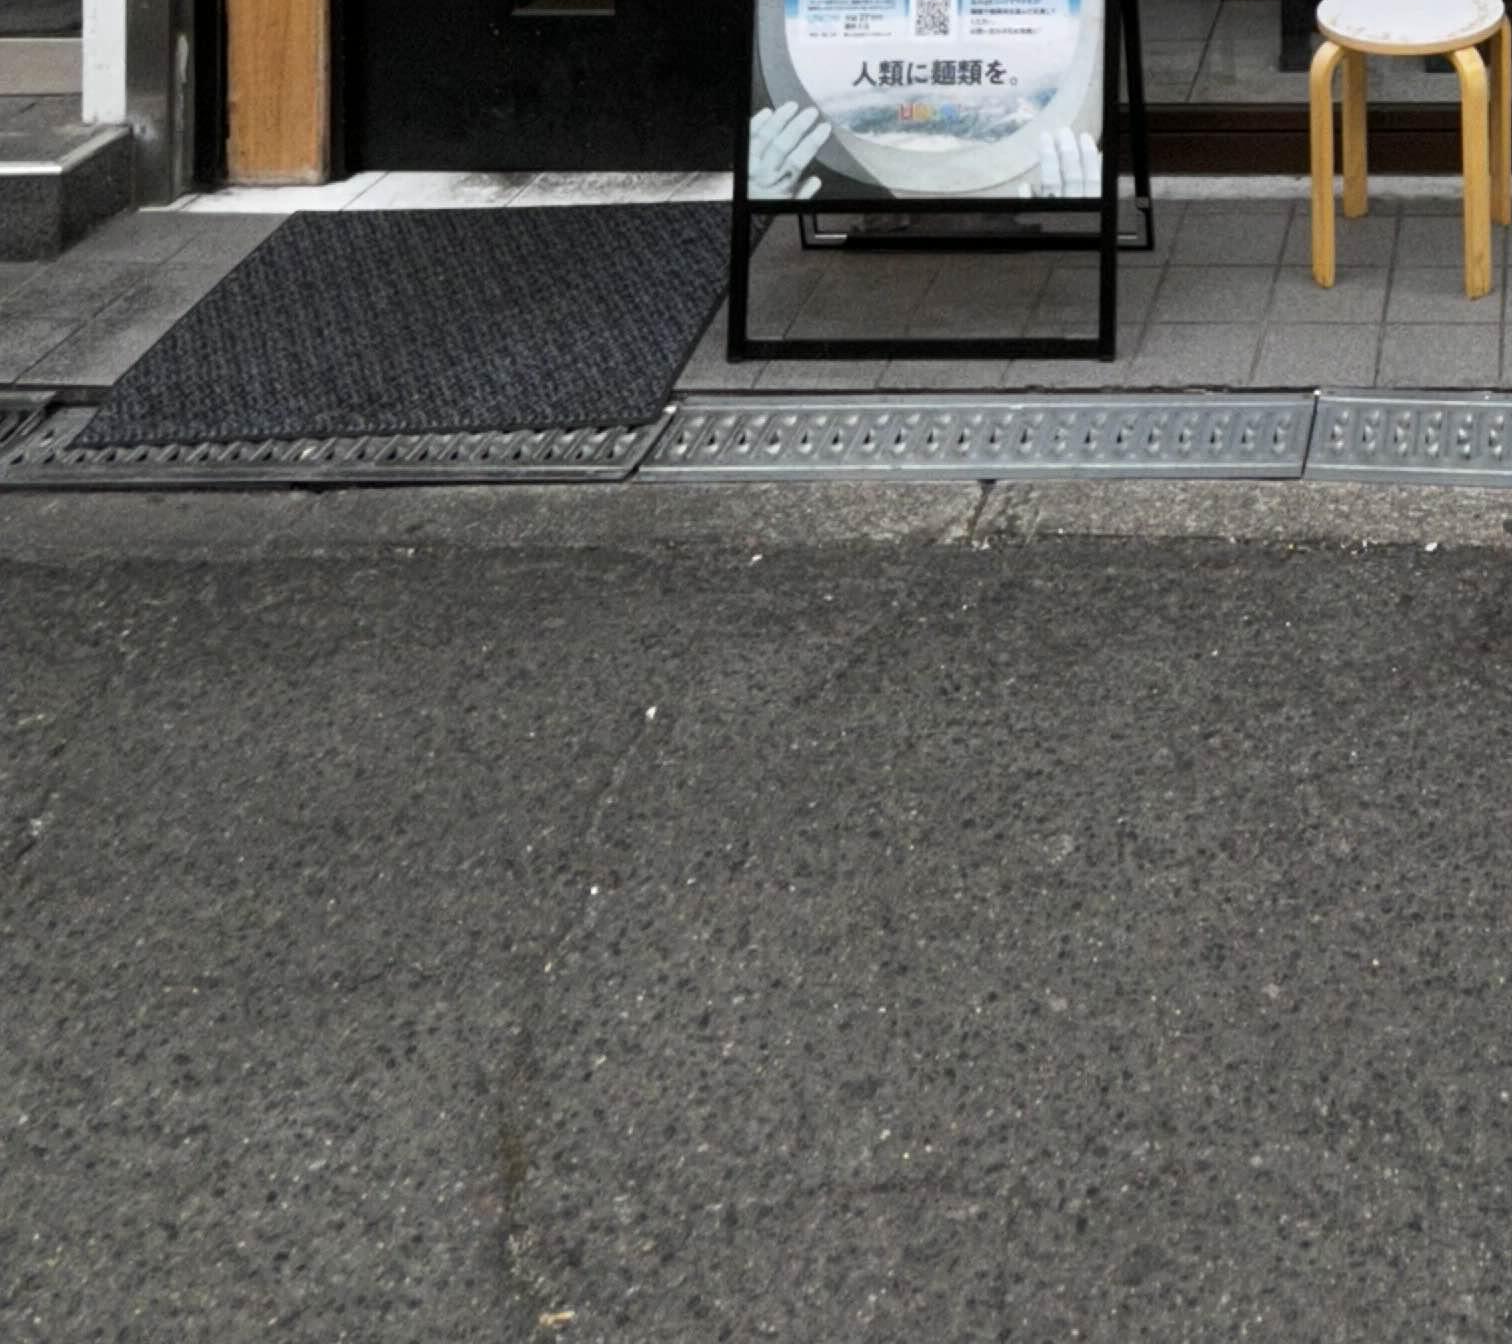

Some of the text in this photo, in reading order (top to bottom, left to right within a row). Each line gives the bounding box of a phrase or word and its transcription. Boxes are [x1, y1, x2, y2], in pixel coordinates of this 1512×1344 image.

[852, 60, 1018, 87] 人類に麺類を。
